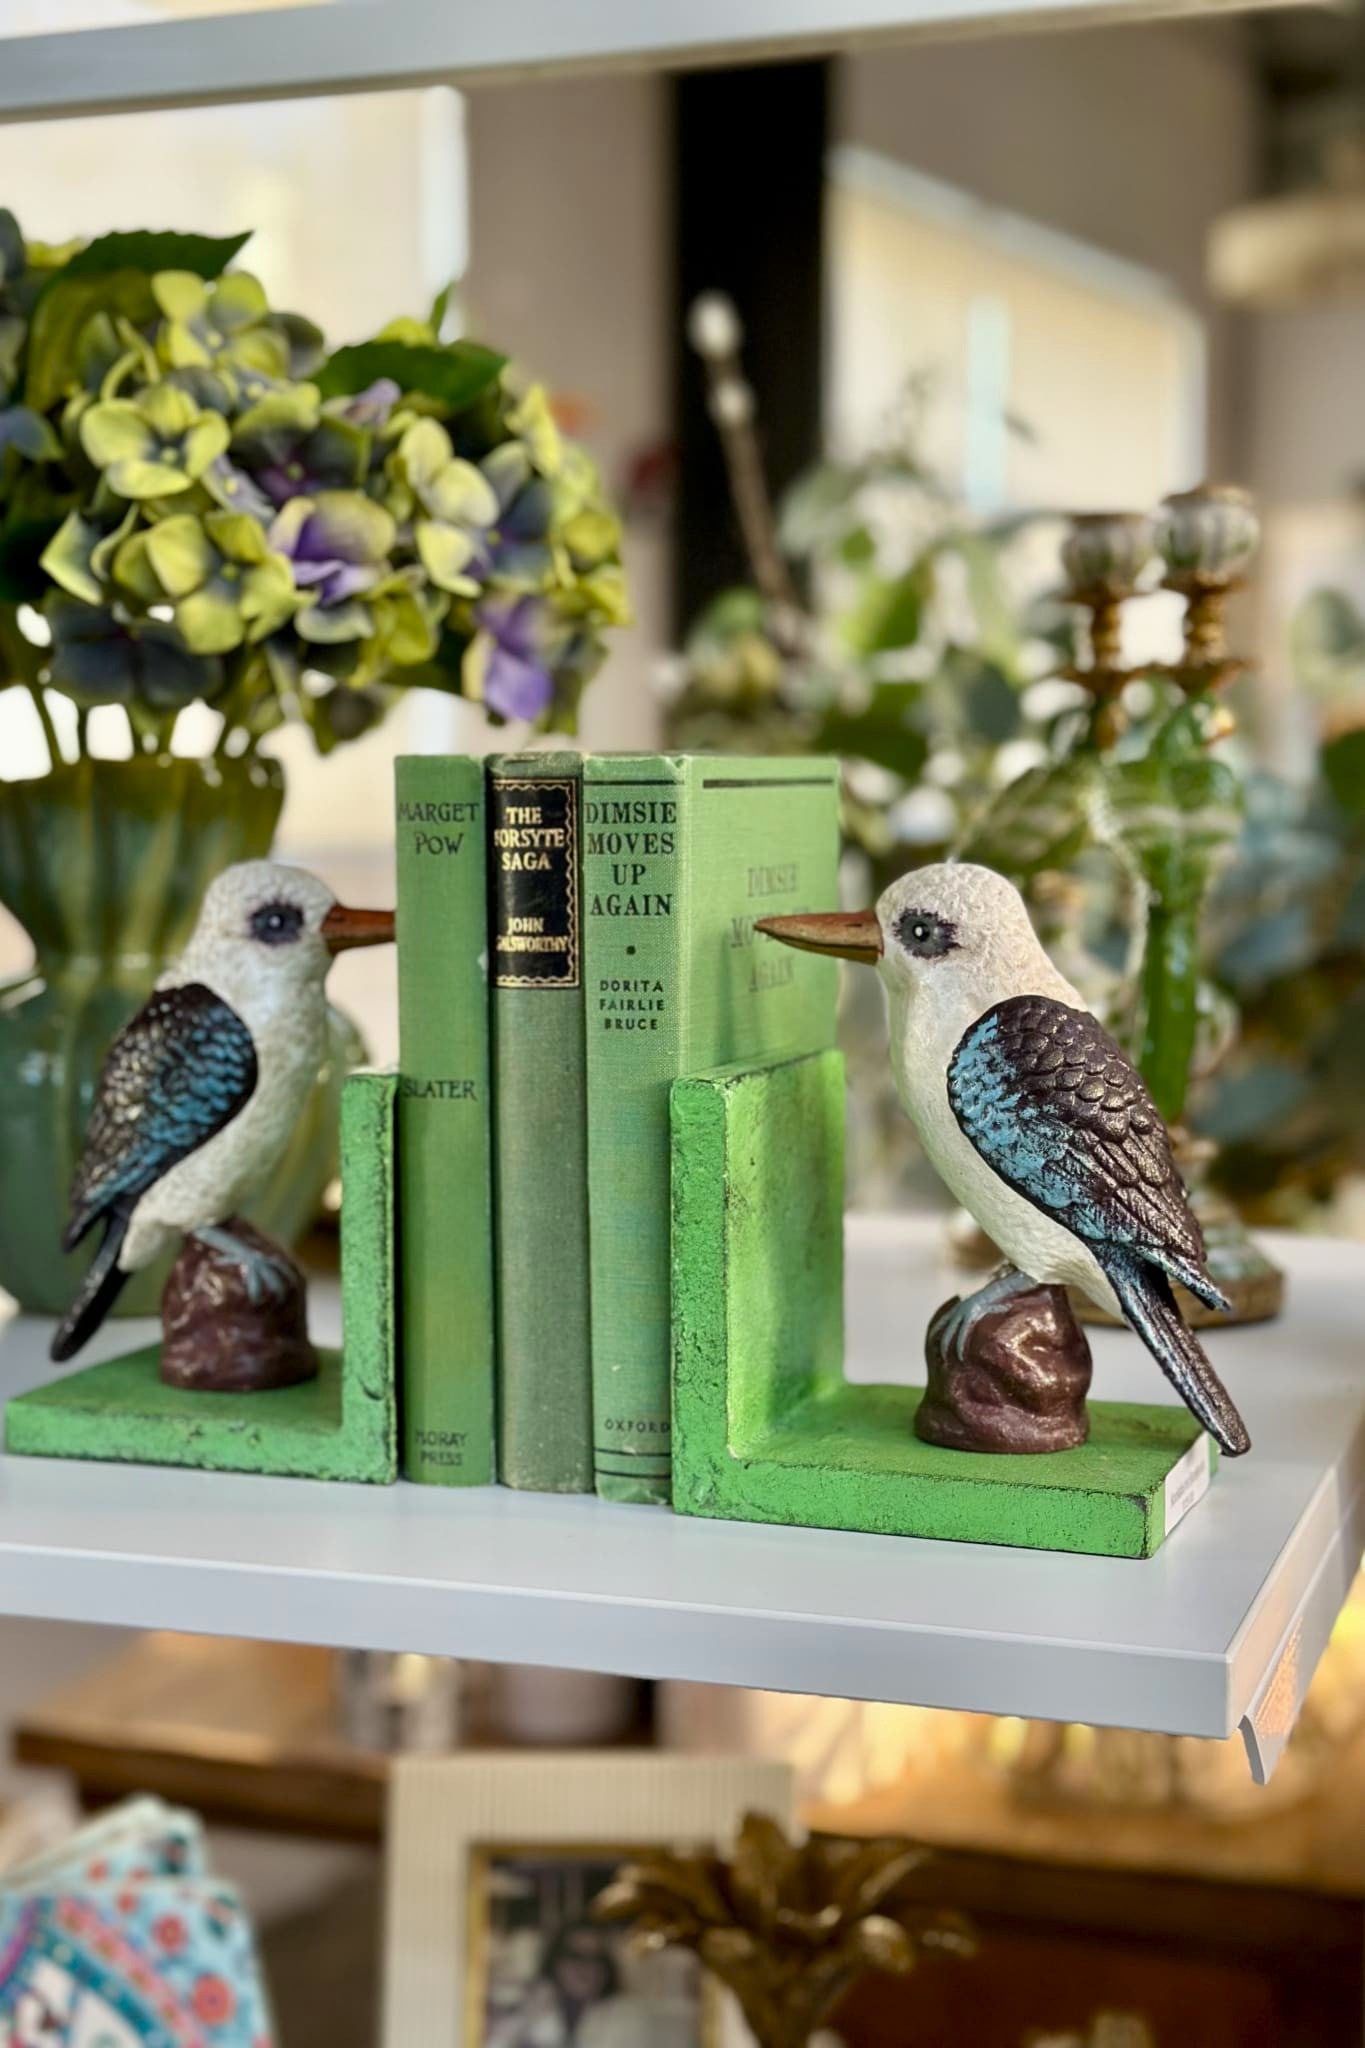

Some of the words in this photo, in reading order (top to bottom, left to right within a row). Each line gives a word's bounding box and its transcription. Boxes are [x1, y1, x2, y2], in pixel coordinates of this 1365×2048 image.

[506, 806, 542, 825] THE
[585, 801, 677, 824] DIMSIE
[414, 831, 464, 856] POW
[494, 828, 565, 848] FORSYTE
[587, 832, 675, 855] MOVES
[501, 851, 552, 871] SAGA
[611, 863, 646, 886] UP
[590, 893, 673, 917] AGAIN
[506, 917, 544, 936] JOHN
[600, 980, 664, 993] DORITA
[599, 998, 665, 1011] FAIRLIE
[604, 1018, 659, 1031] BRUCE
[403, 1077, 479, 1103] SLATER
[604, 1418, 672, 1434] OXFORD
